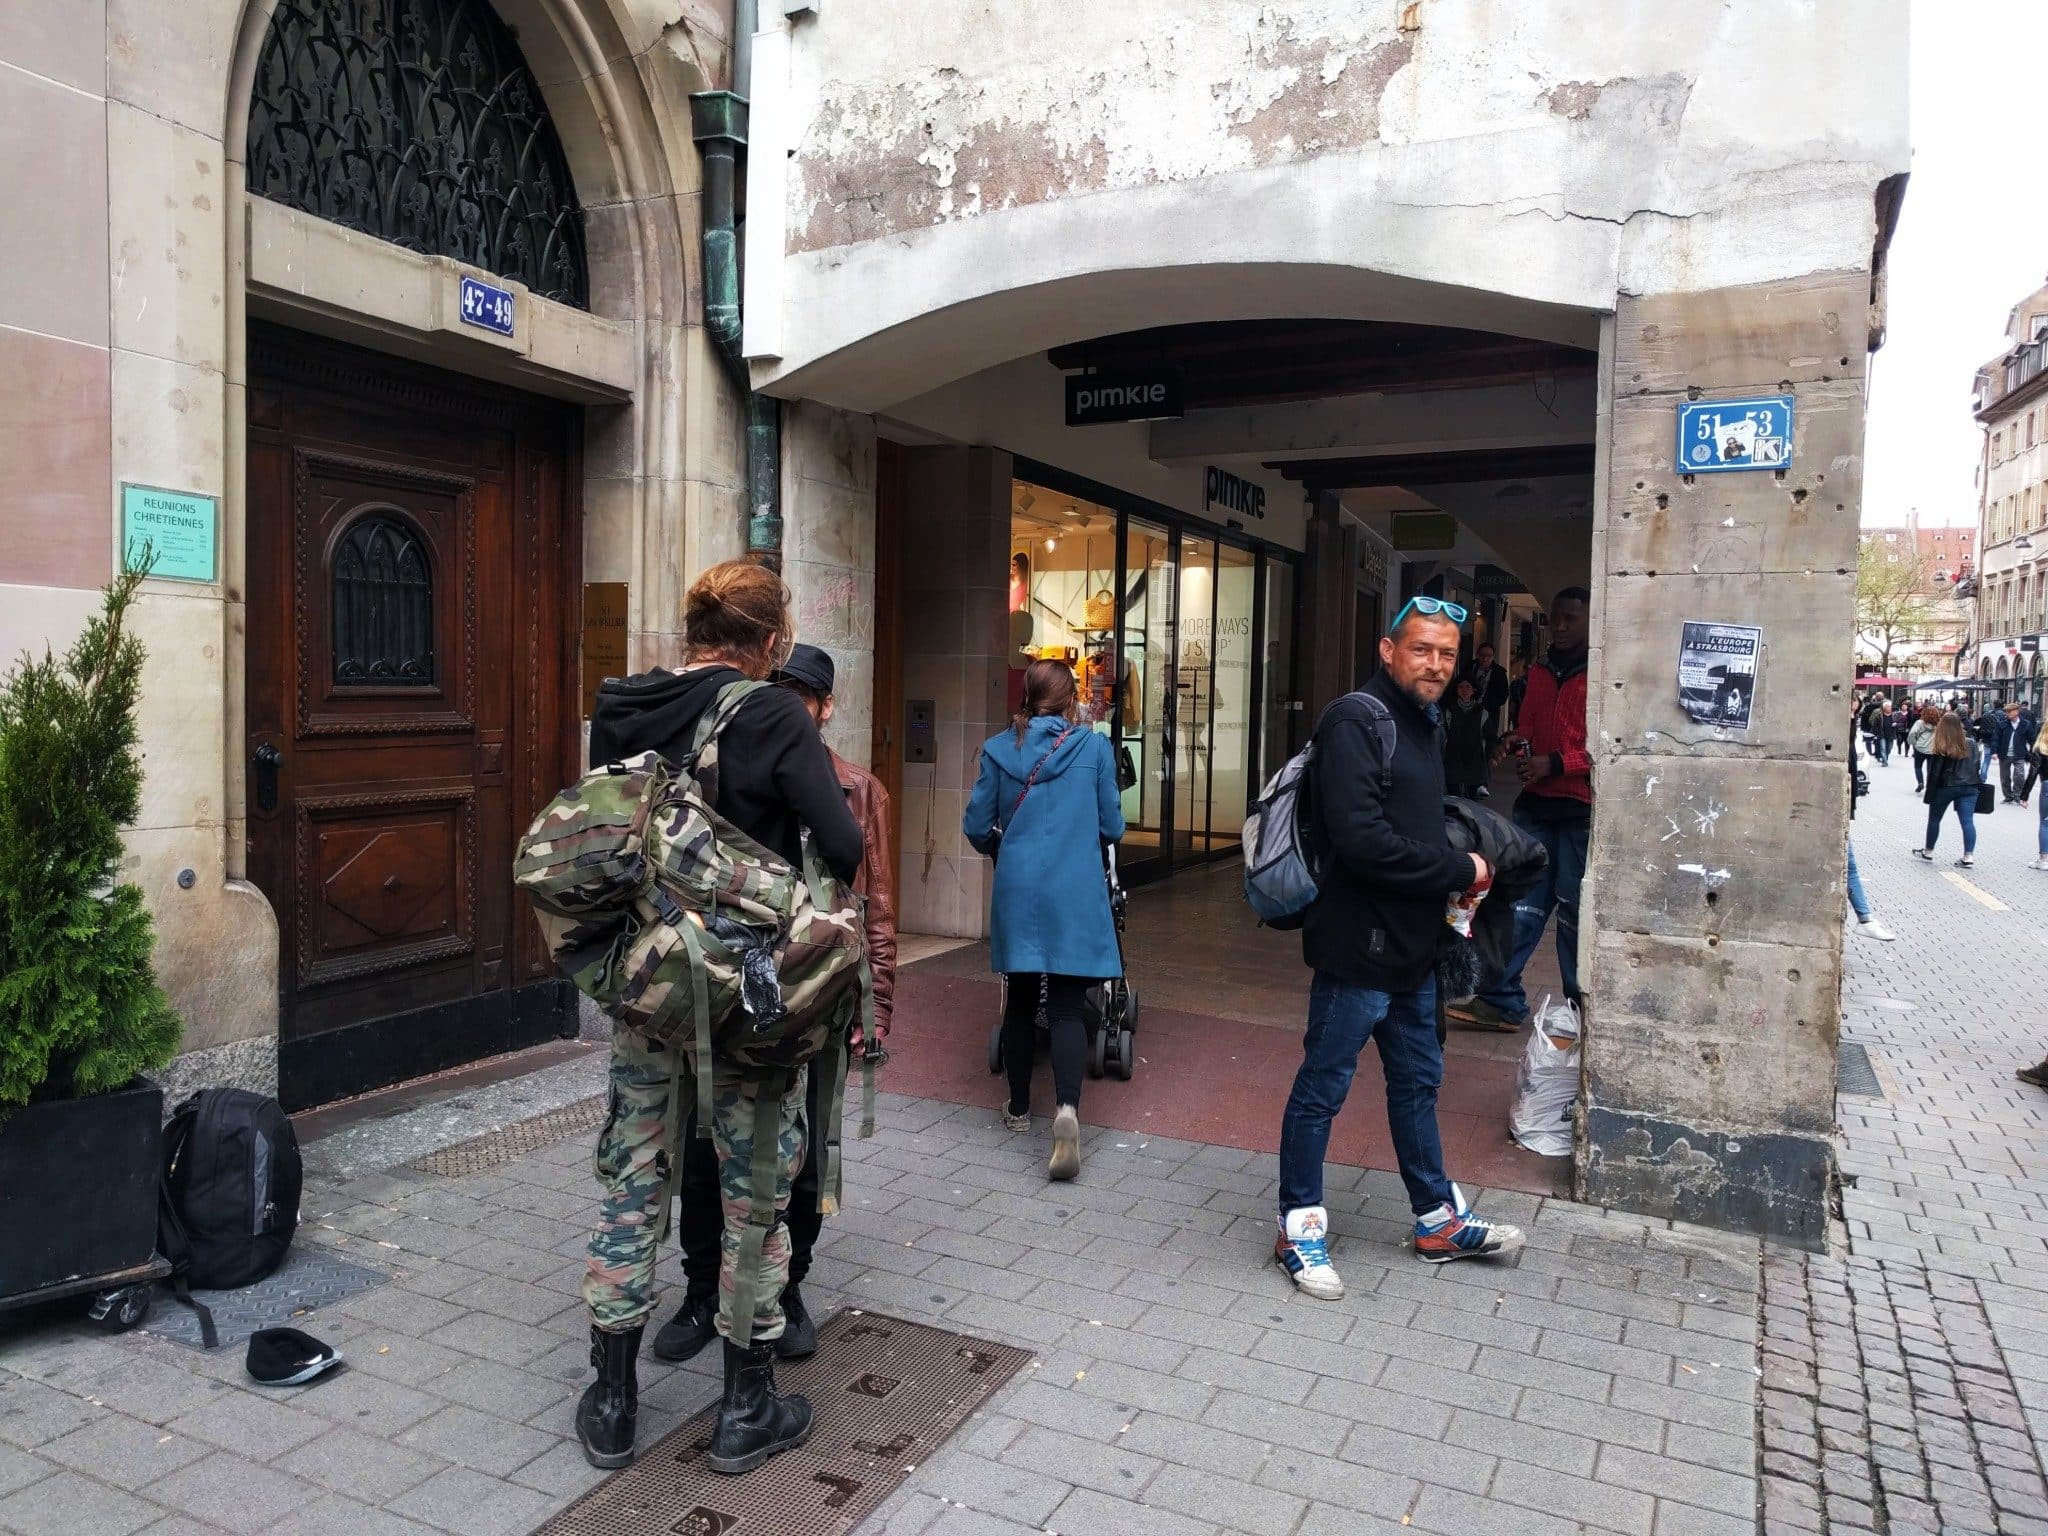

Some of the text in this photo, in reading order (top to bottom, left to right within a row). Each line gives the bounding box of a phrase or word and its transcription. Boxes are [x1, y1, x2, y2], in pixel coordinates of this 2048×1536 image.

[464, 286, 512, 327] 47-49
[1076, 383, 1166, 414] pimkie
[1206, 465, 1266, 520] pimkie
[143, 497, 197, 514] REUNIONS
[133, 511, 205, 530] CHRETIENNES
[1215, 617, 1249, 635] WAYS
[1696, 643, 1752, 654] STRASBOURG
[1710, 637, 1753, 647] L'EUROPE
